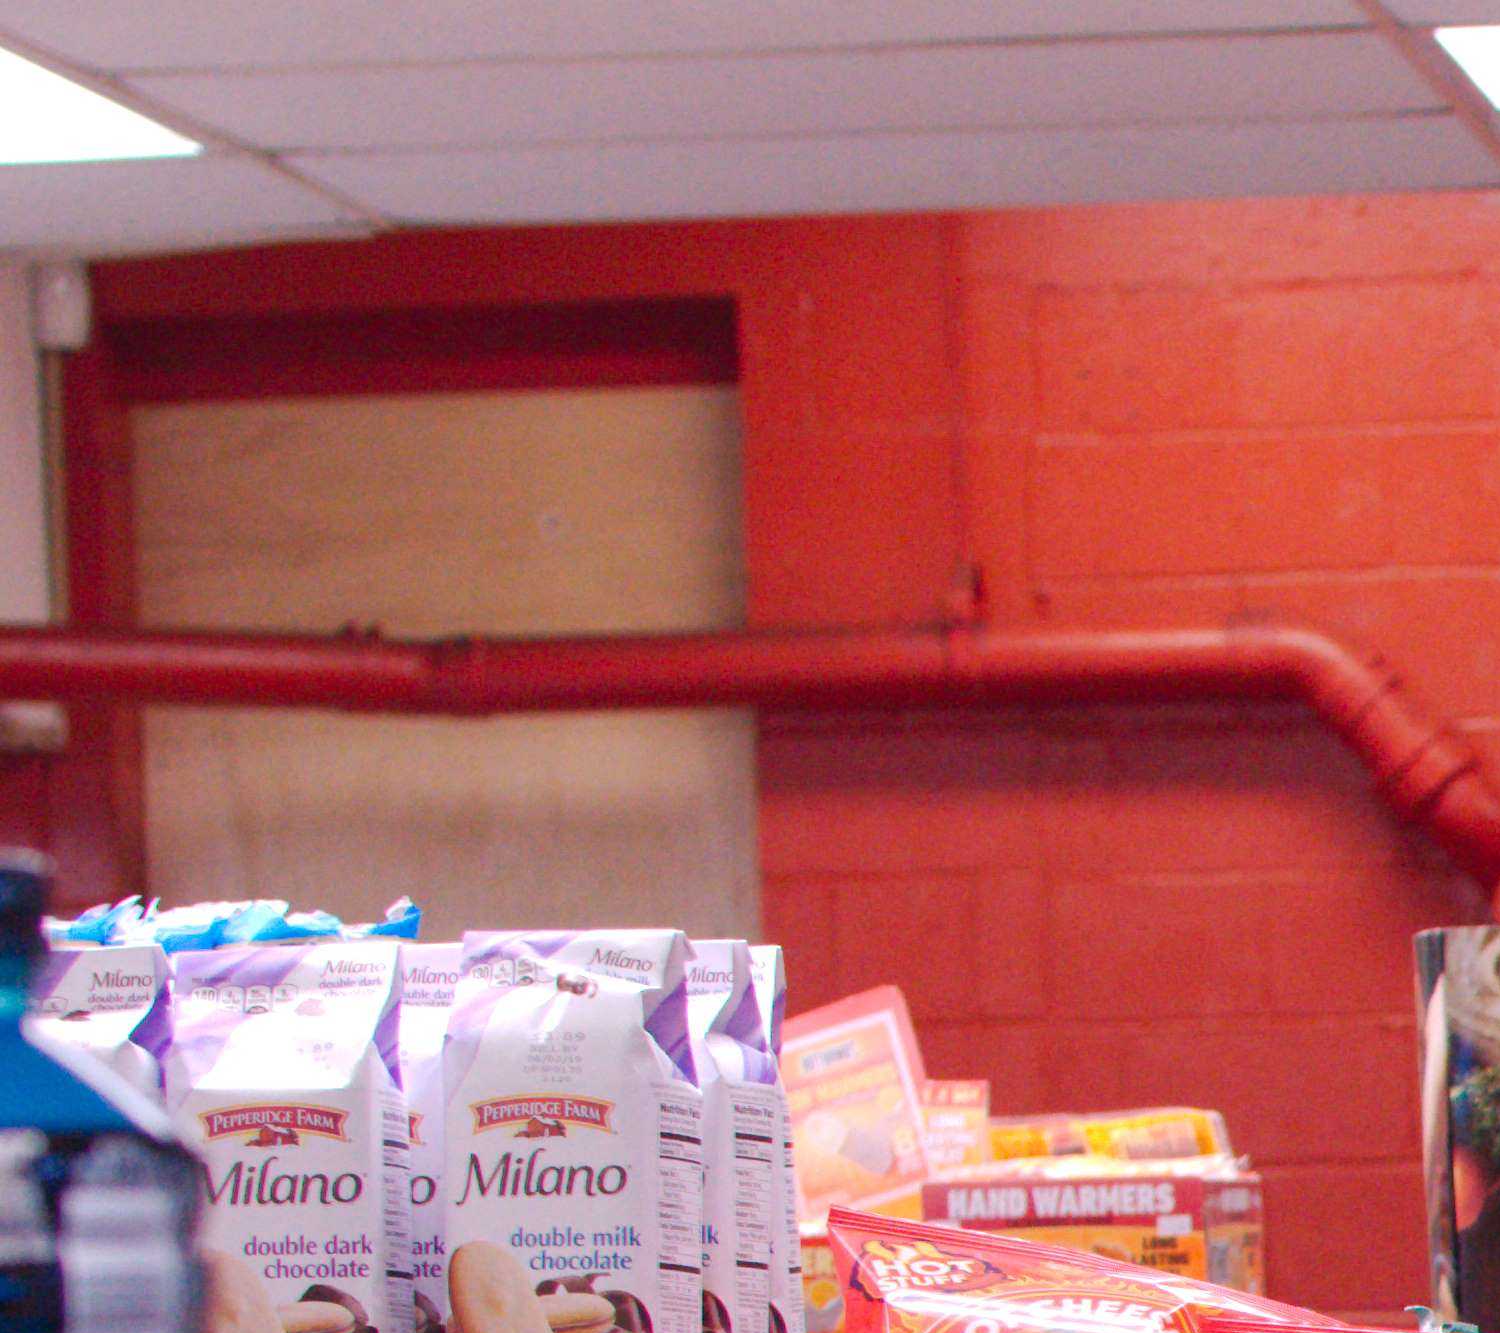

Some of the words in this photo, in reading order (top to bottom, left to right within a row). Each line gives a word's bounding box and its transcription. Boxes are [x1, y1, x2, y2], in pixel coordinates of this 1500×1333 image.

[321, 959, 386, 979] Milano
[590, 948, 653, 973] Milano
[90, 968, 154, 993] Milano
[212, 1110, 294, 1134] PEPPERIDGE
[296, 1109, 337, 1131] FARM
[483, 1099, 562, 1122] PEPPERIDGE
[563, 1098, 601, 1121] FARM
[202, 1155, 364, 1208] Milano
[455, 1147, 628, 1207] Milano
[947, 1186, 1029, 1220] HAND
[1032, 1182, 1177, 1216] WARMERS
[243, 1236, 318, 1257] double
[324, 1234, 373, 1256] dark
[510, 1226, 585, 1249] double
[593, 1225, 642, 1248] milk
[263, 1259, 371, 1280] chocolate
[529, 1250, 633, 1272] chocolate
[871, 1258, 976, 1279] HOT
[879, 1271, 970, 1292] STUFF
